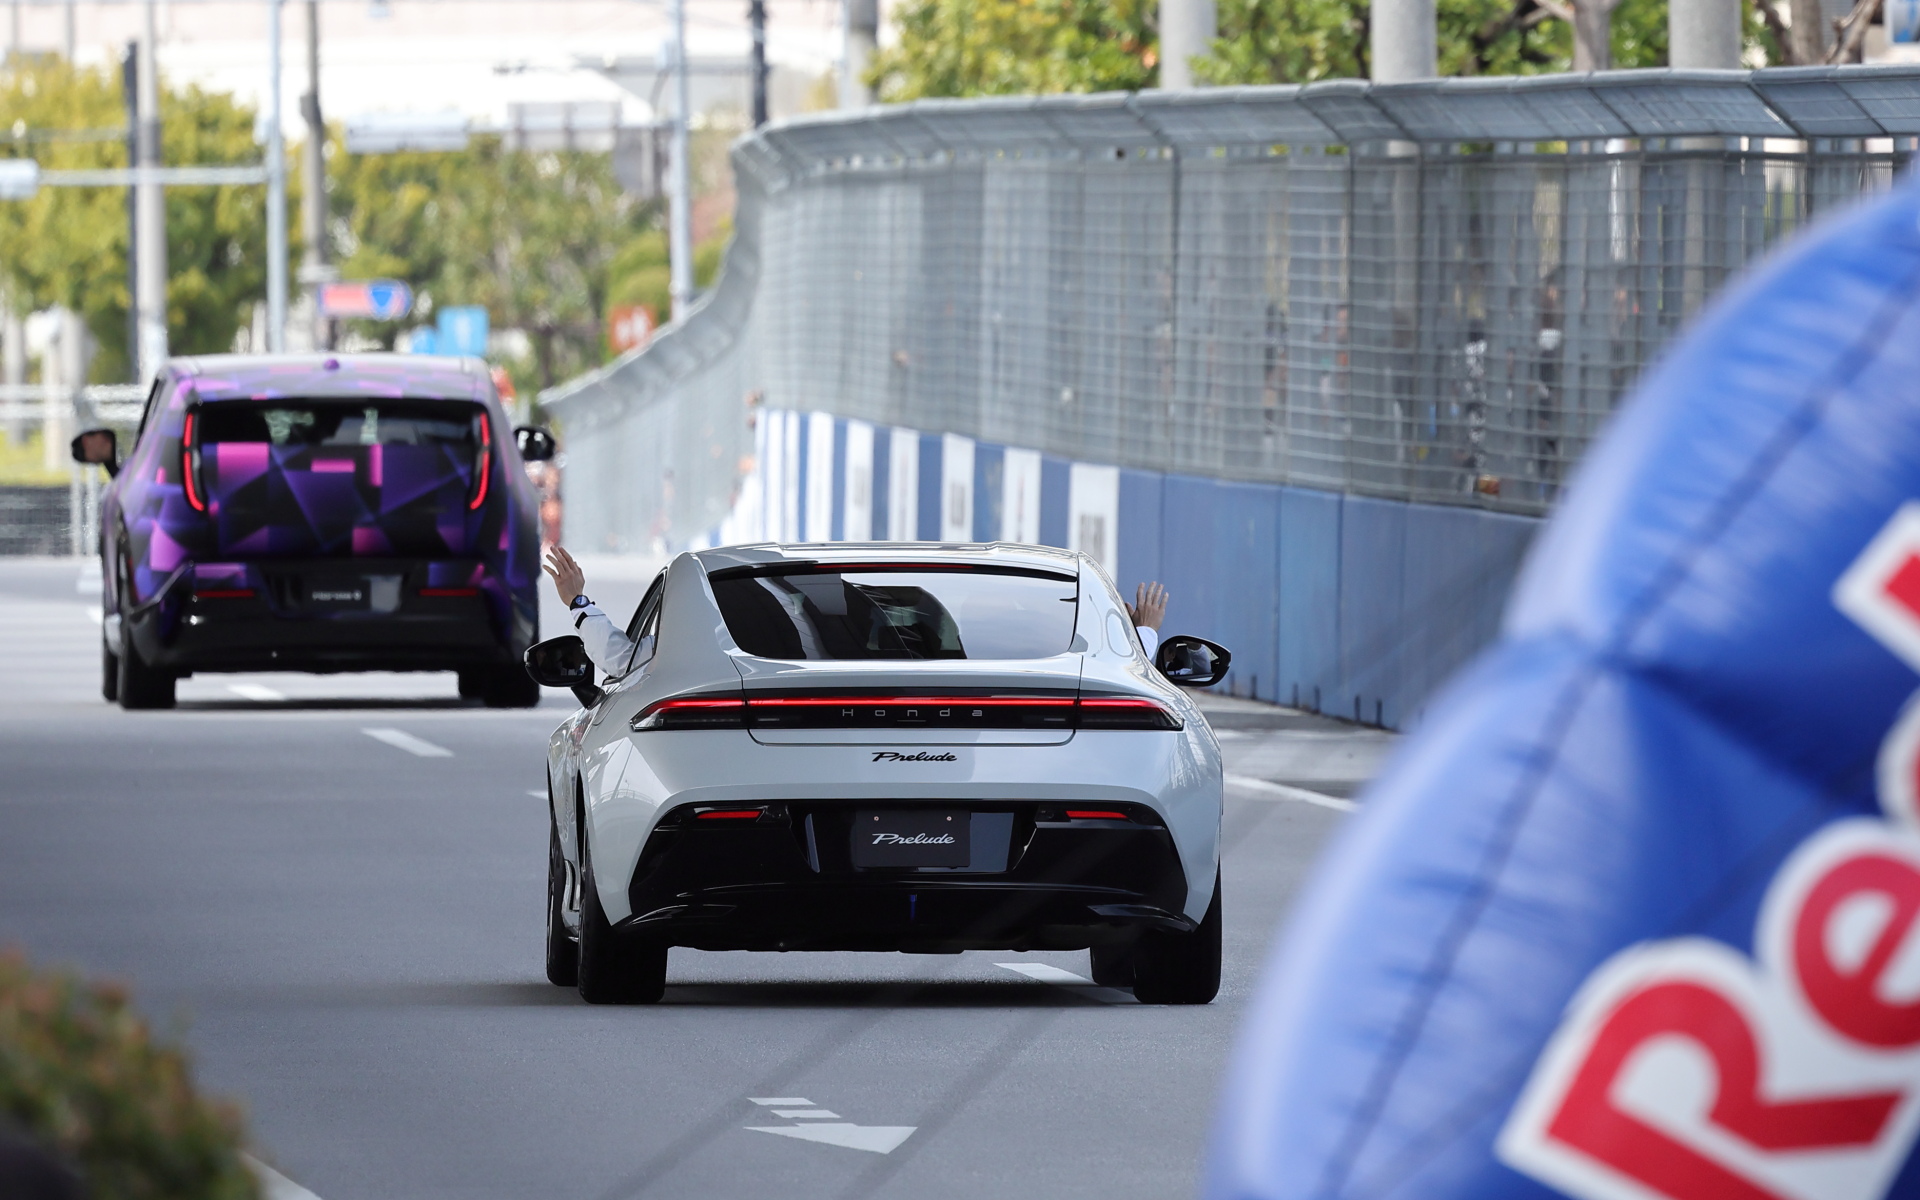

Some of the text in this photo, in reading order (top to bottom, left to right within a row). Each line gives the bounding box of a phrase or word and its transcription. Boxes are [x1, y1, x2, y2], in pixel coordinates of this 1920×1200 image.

[842, 708, 983, 717] Honda
[872, 751, 958, 762] Prelude
[872, 833, 955, 845] Prelude
[1495, 530, 1920, 1200] Re
